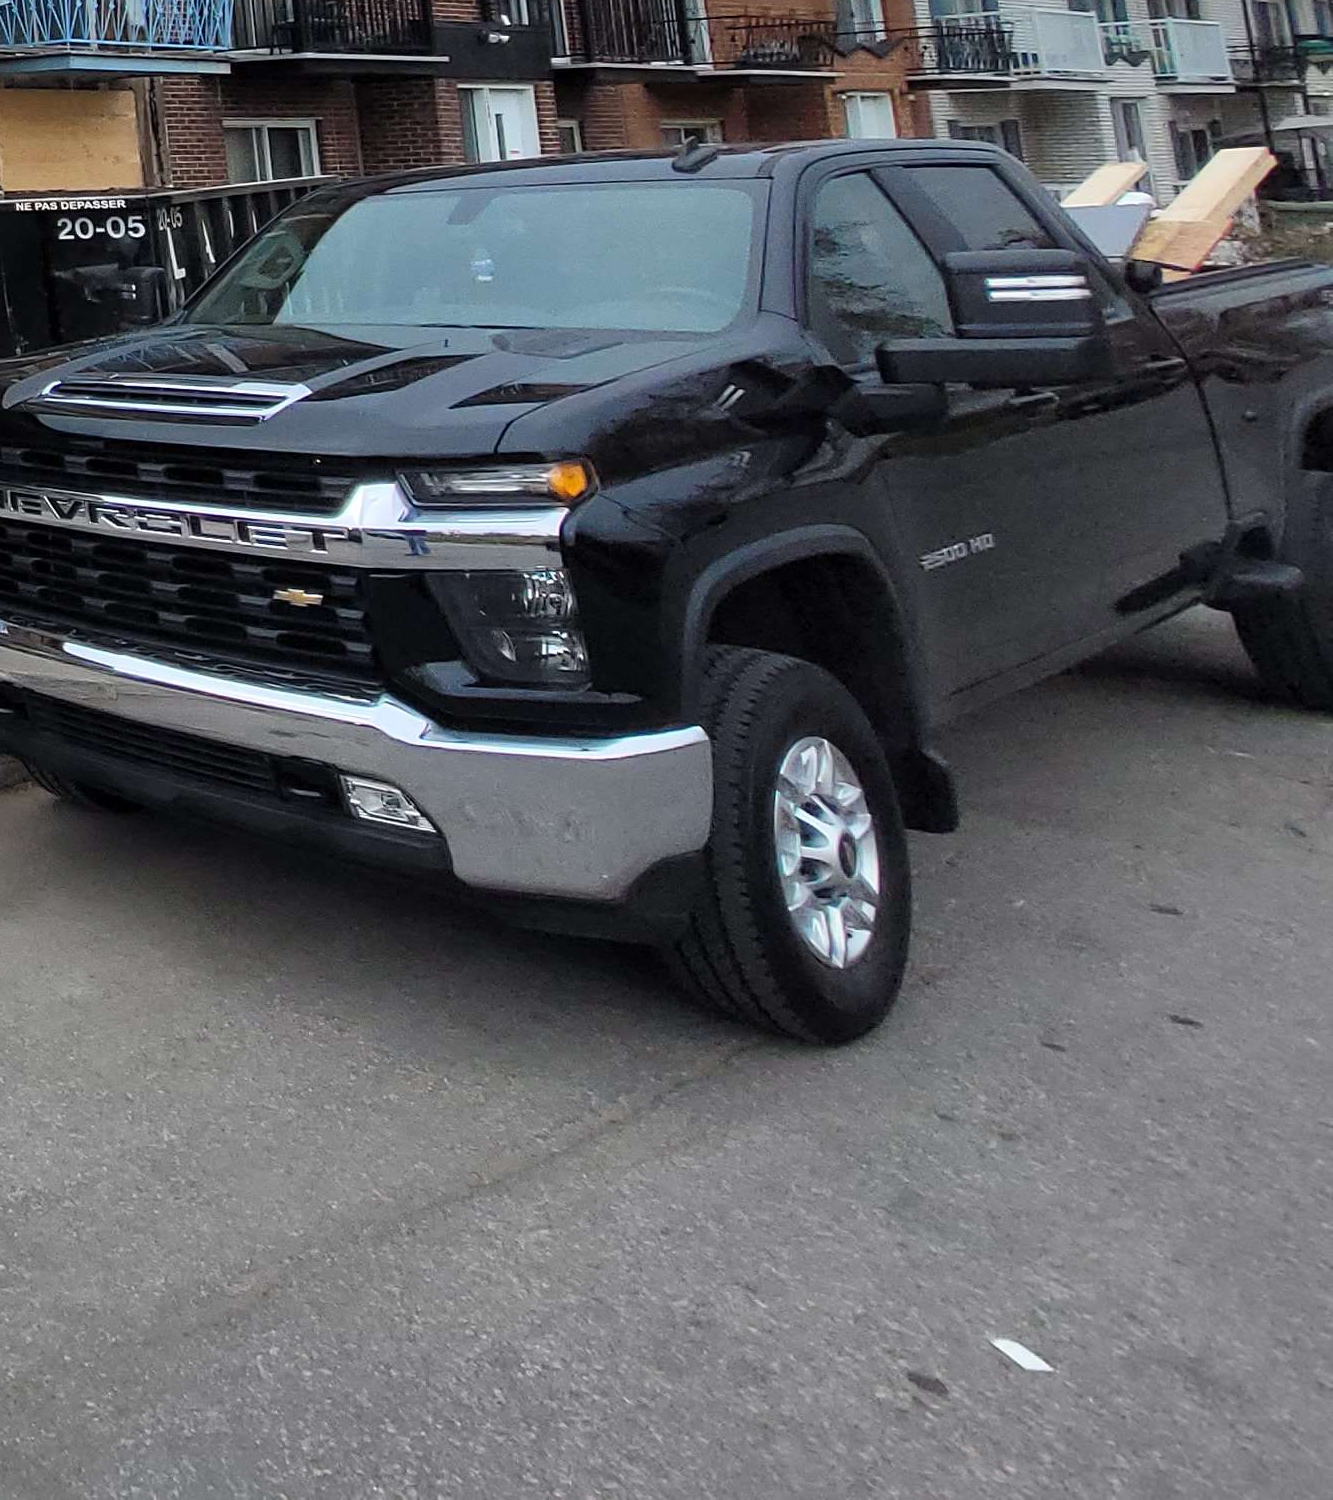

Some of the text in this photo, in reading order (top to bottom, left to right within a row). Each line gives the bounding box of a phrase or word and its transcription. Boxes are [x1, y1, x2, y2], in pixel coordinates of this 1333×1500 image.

[15, 199, 127, 211] NE PAS DEPASSER
[56, 215, 146, 240] 20-05
[969, 533, 996, 554] HD
